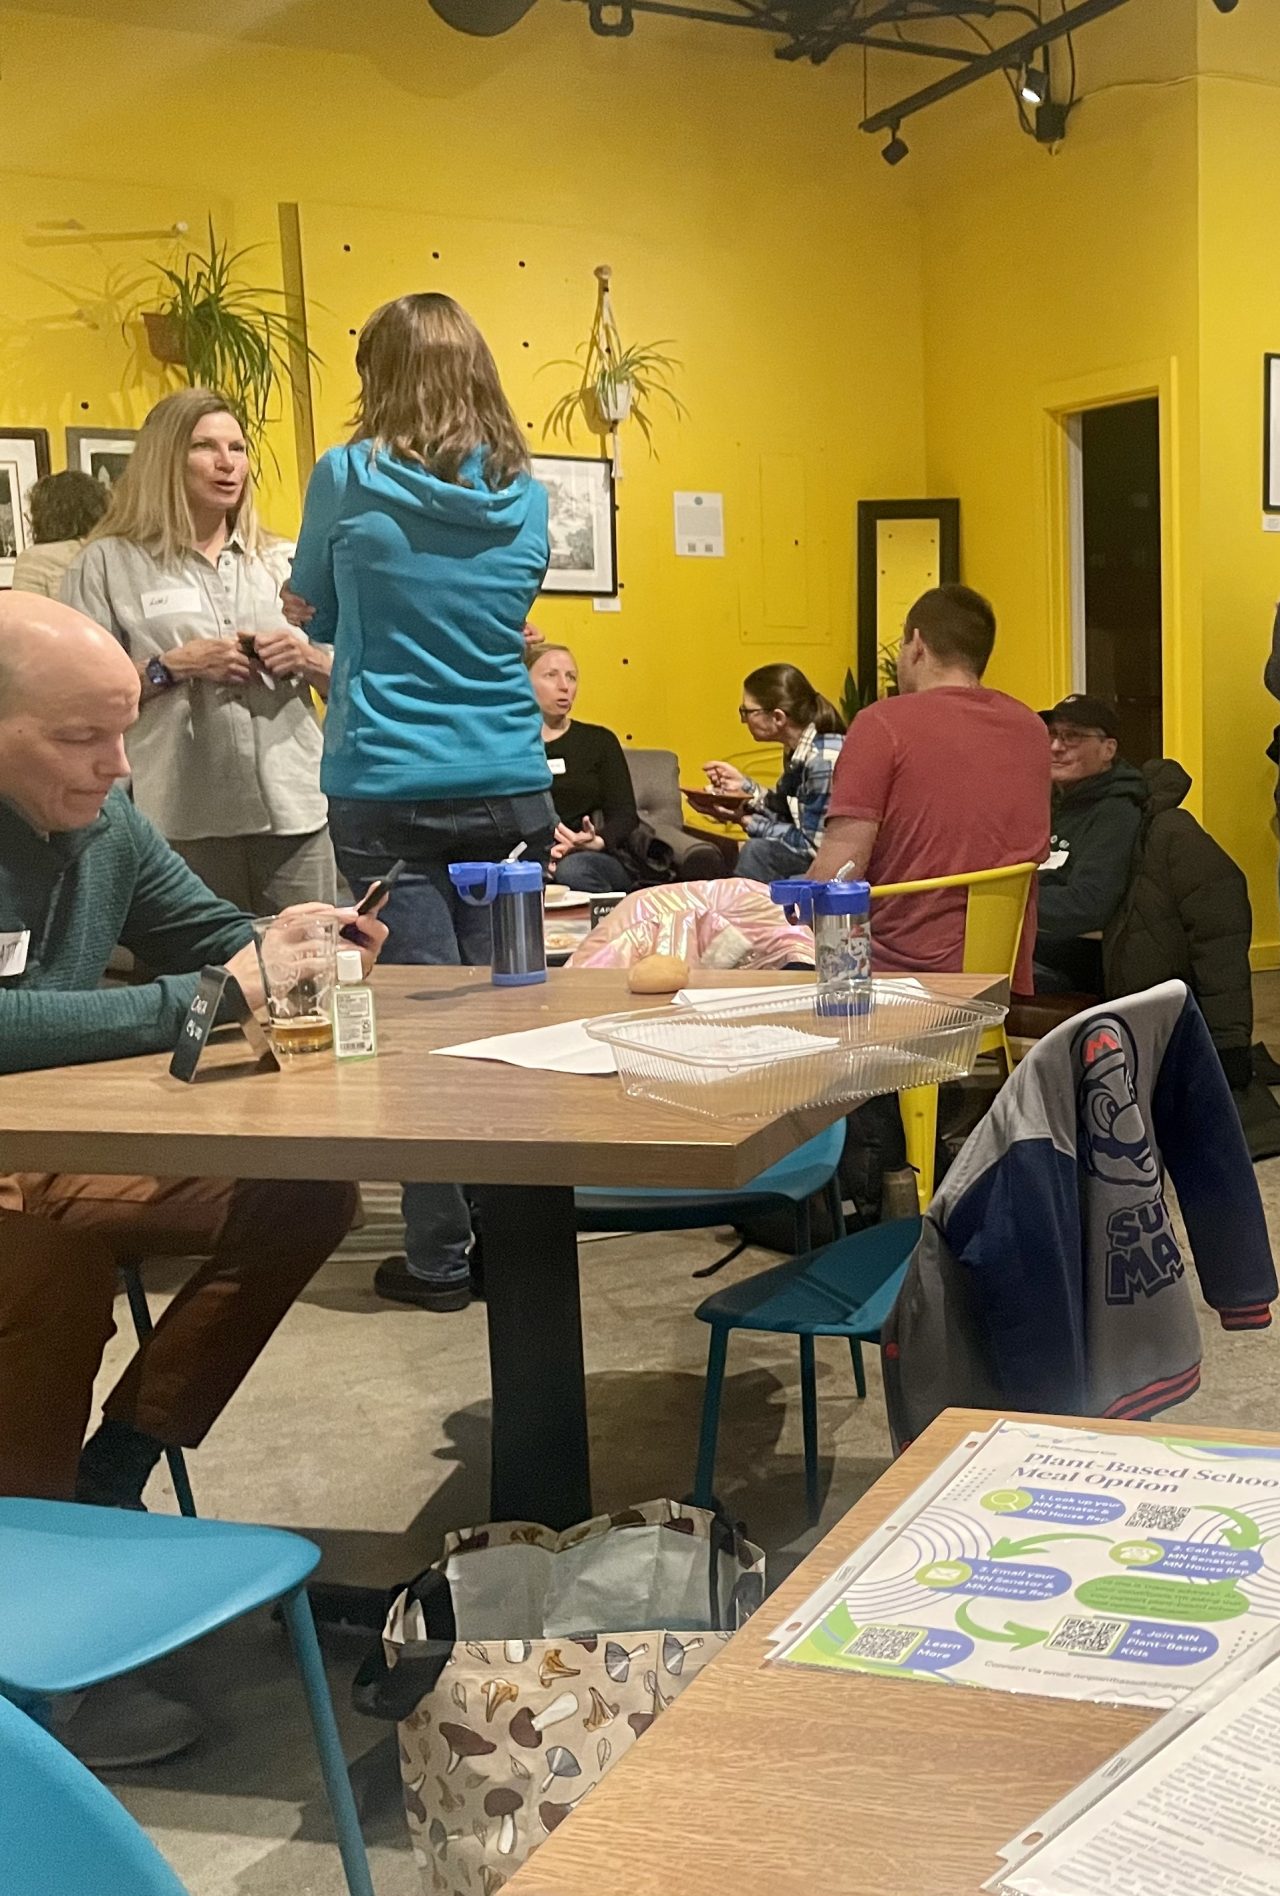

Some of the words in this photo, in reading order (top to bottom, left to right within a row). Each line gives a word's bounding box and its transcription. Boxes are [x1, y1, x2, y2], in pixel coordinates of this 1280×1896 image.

[1107, 1200, 1166, 1250] SU
[1106, 1231, 1185, 1306] MA
[1024, 1453, 1190, 1480] Plant-Based
[1011, 1466, 1080, 1482] Meal
[1084, 1472, 1180, 1494] Option
[1027, 1508, 1047, 1516] MN
[1048, 1511, 1085, 1520] House
[1054, 1503, 1098, 1513] Senator
[1188, 1546, 1209, 1554] Call
[1212, 1550, 1239, 1558] your
[1167, 1553, 1189, 1561] MN
[1190, 1555, 1237, 1566] Senator
[1162, 1560, 1183, 1568] MN
[1185, 1562, 1224, 1573] House
[991, 1568, 1025, 1577] Email
[1027, 1572, 1055, 1580] your
[972, 1574, 992, 1583] MN
[994, 1576, 1042, 1588] Senator
[964, 1582, 986, 1591] MN
[988, 1584, 1027, 1595] House
[1146, 1629, 1175, 1641] Join
[1176, 1634, 1200, 1642] MN
[924, 1639, 963, 1650] Learn
[1126, 1638, 1208, 1653] Plant-Based
[916, 1649, 951, 1659] More
[1120, 1647, 1149, 1658] Kids
